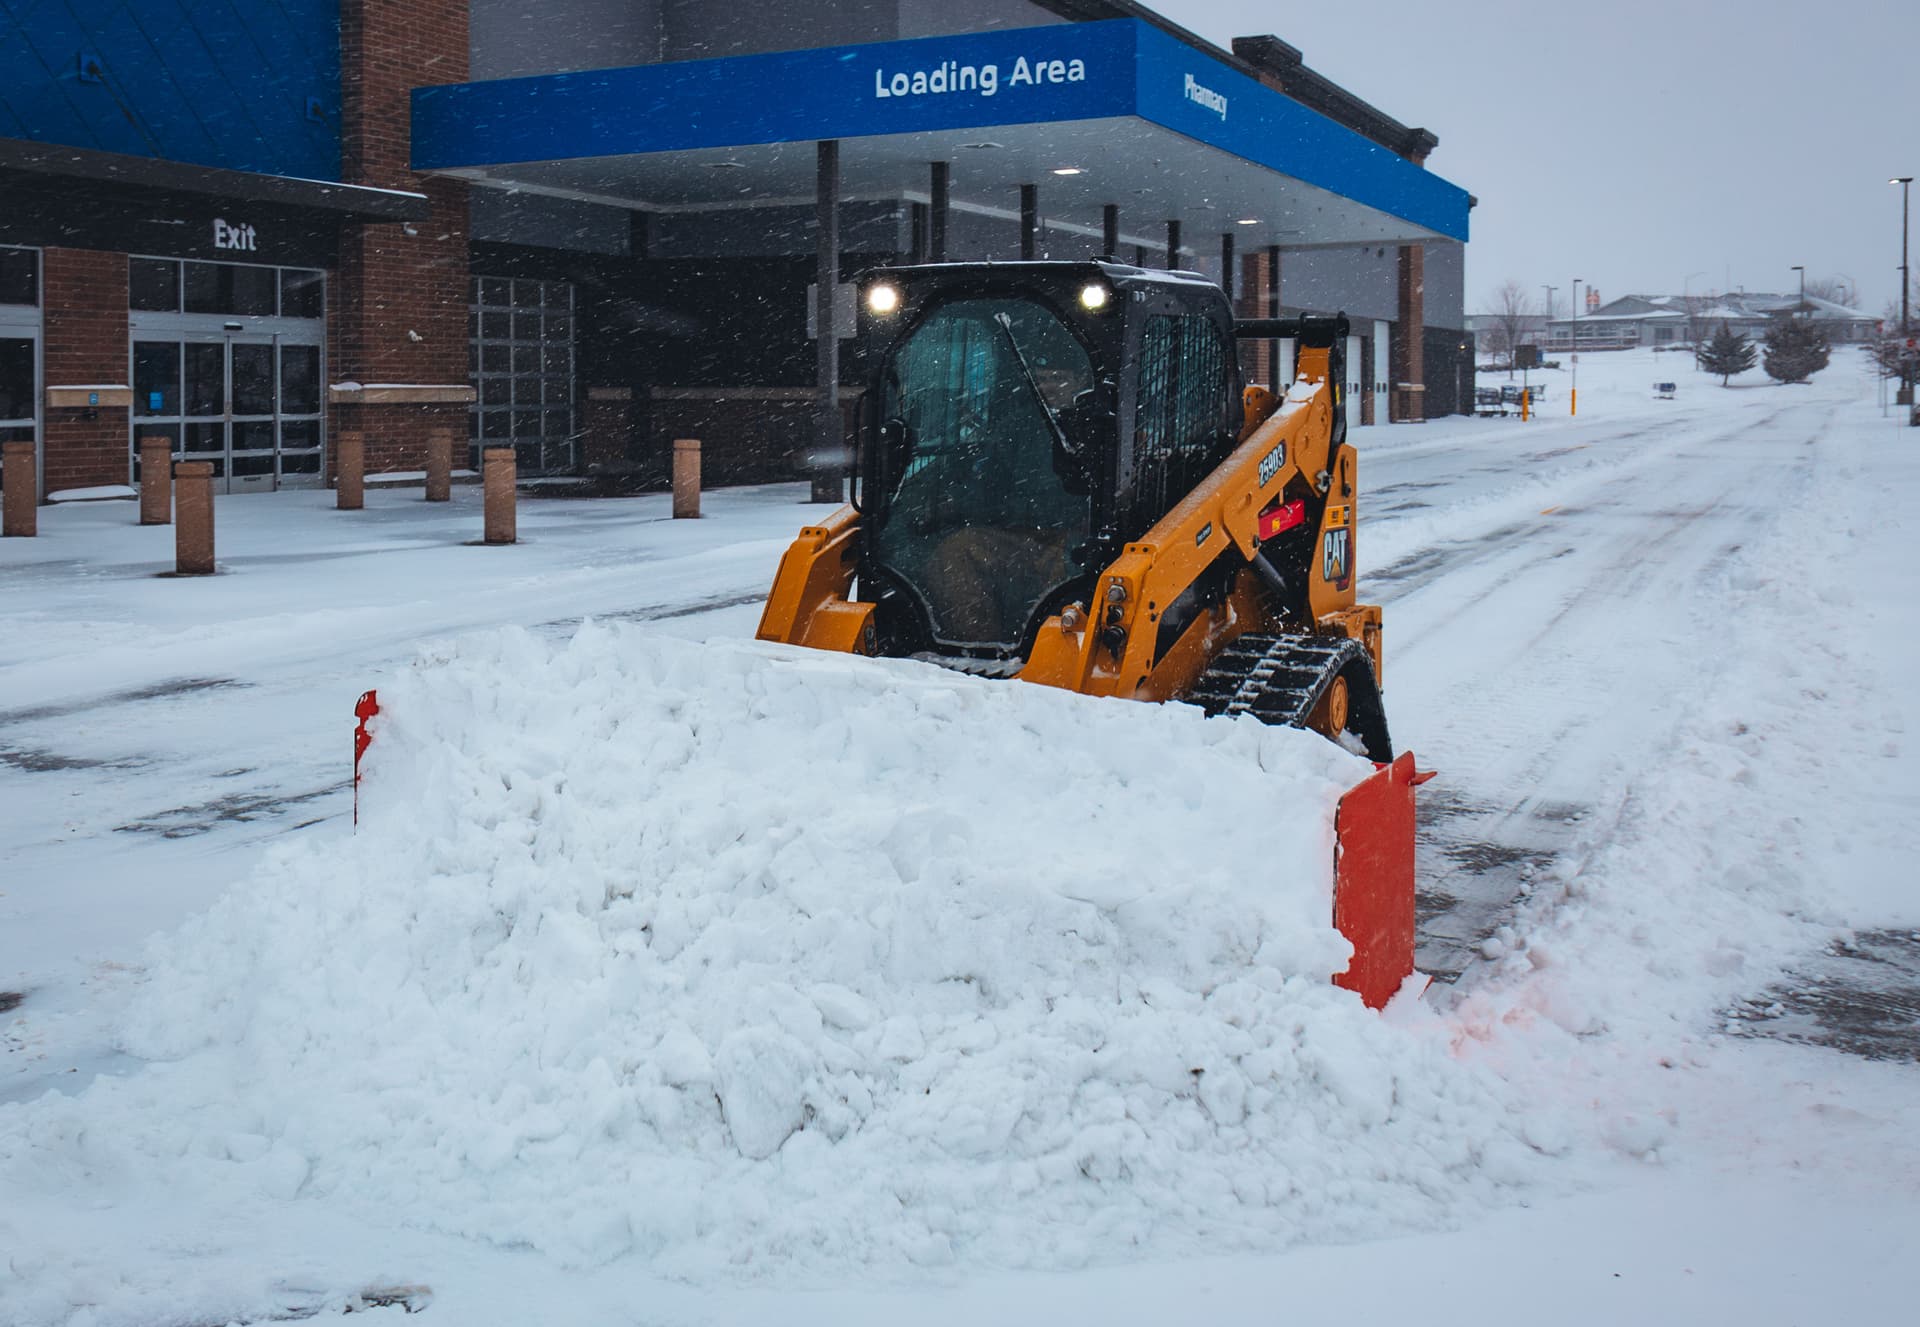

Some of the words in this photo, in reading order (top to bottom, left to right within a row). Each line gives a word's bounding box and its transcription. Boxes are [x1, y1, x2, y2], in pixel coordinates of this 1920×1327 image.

[875, 60, 998, 97] Loading
[1009, 56, 1085, 86] Area
[1184, 73, 1227, 121] Pharmacy
[214, 218, 257, 251] Exit
[1324, 529, 1348, 580] CAT
